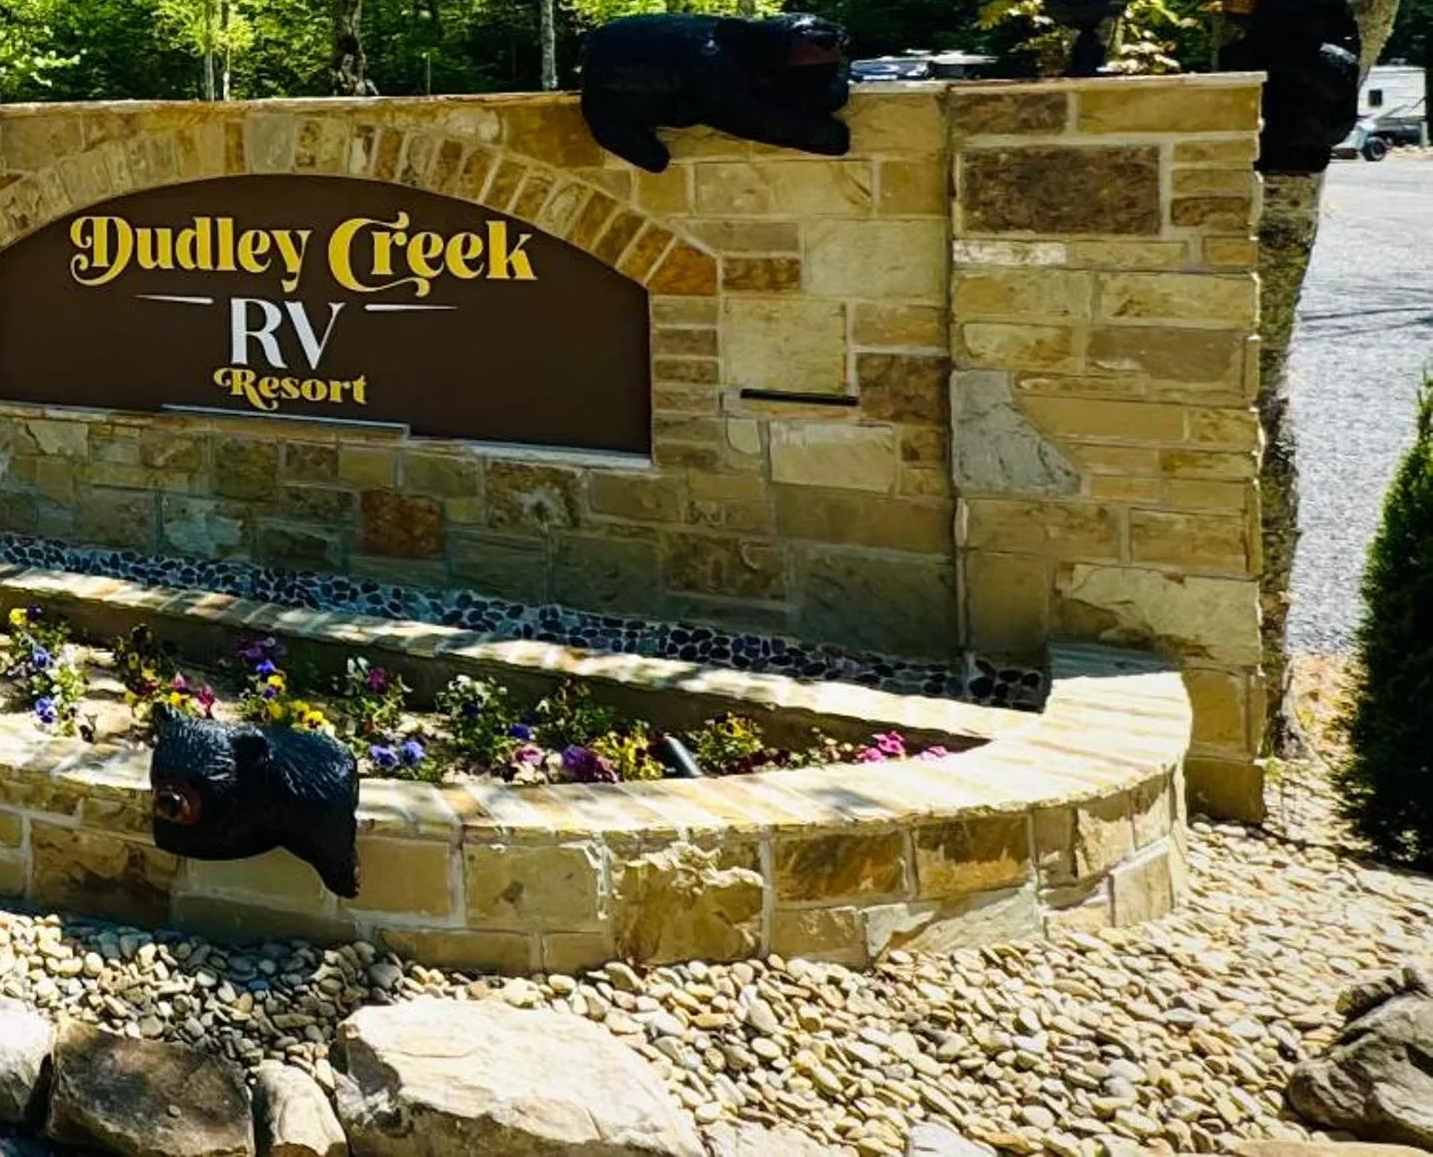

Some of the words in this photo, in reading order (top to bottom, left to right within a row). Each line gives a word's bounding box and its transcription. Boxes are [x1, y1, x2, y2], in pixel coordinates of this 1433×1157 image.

[69, 215, 313, 293] Dudley
[328, 211, 539, 297] Creek
[229, 297, 347, 370] RV
[212, 367, 368, 411] Resort
